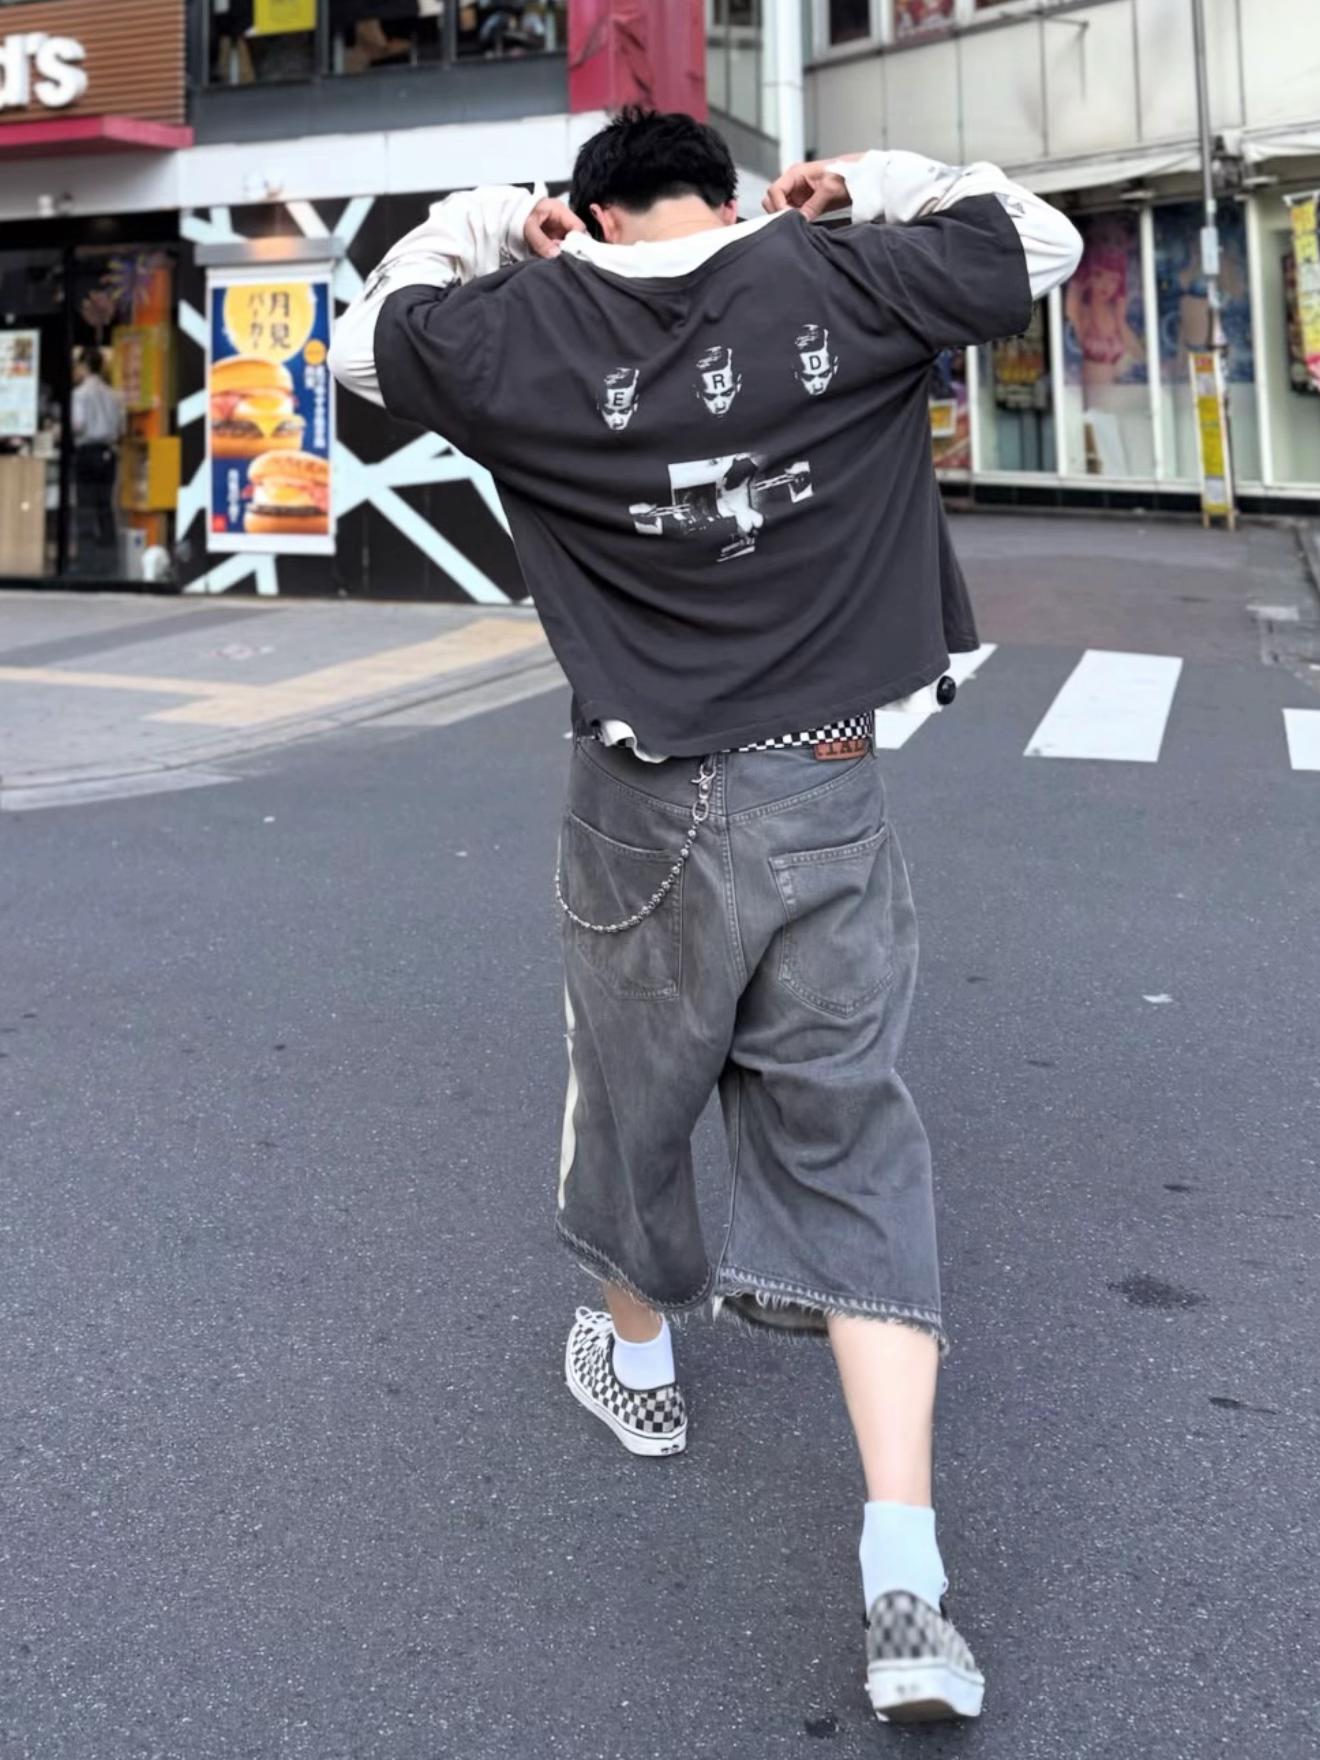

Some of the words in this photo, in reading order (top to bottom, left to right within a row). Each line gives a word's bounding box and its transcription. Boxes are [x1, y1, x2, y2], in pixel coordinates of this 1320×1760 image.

[270, 291, 291, 349] 月見
[613, 392, 625, 407] E
[713, 374, 725, 390] R
[809, 355, 822, 370] D
